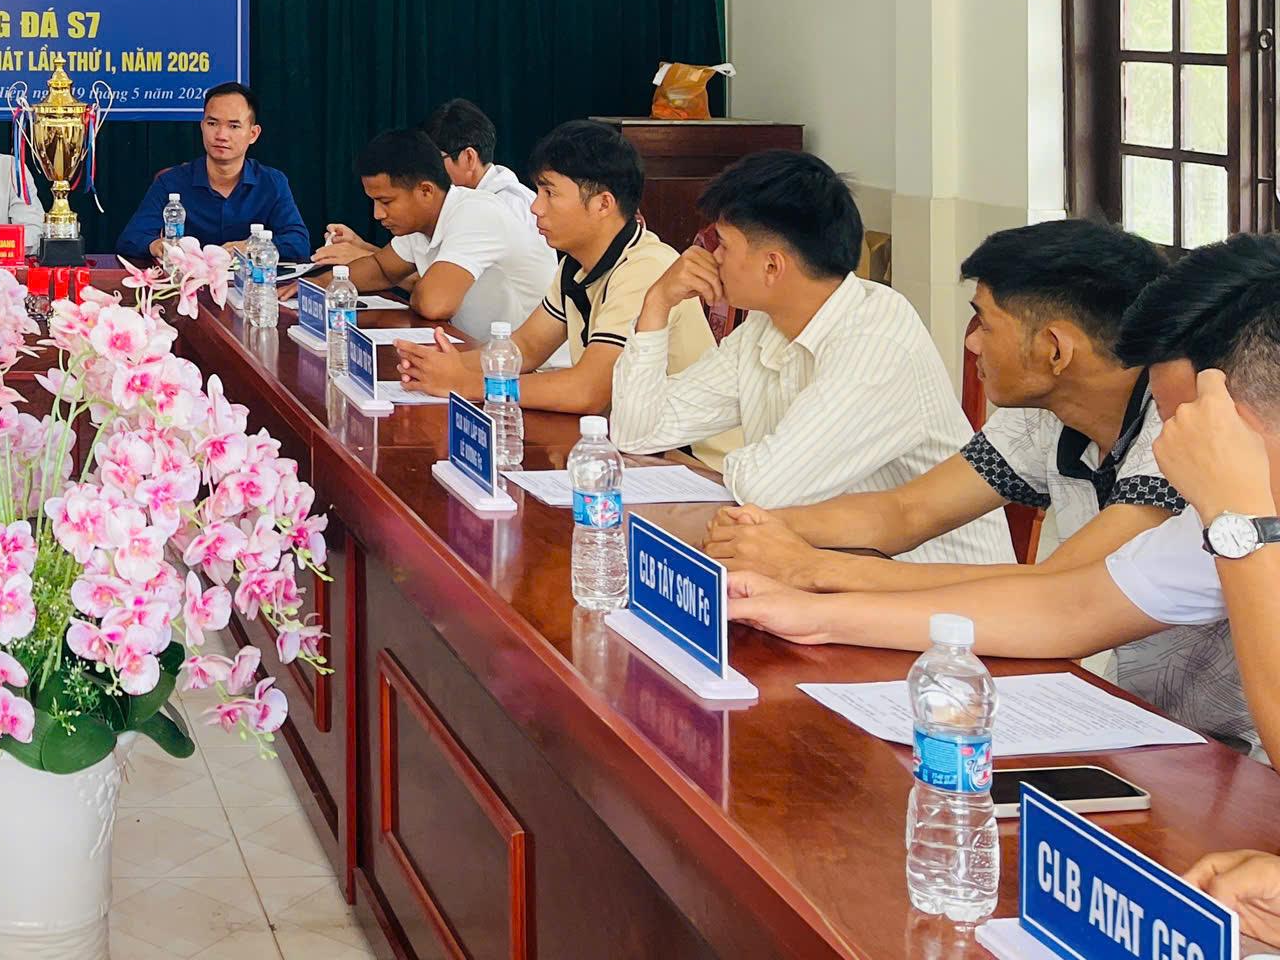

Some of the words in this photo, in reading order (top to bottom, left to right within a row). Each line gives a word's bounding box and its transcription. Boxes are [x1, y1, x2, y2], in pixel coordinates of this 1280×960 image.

[20, 7, 59, 38] ĐÁ
[67, 11, 100, 38] S7
[67, 42, 102, 72] THỨ
[121, 47, 162, 72] NĂM
[167, 51, 210, 72] 2026
[131, 87, 140, 99] 5
[144, 87, 174, 99] năm
[640, 550, 656, 589] CLB
[658, 558, 674, 602] TÂY
[676, 573, 696, 617] SƠN
[1038, 841, 1081, 913] CLB
[1088, 876, 1144, 958] ATAT
